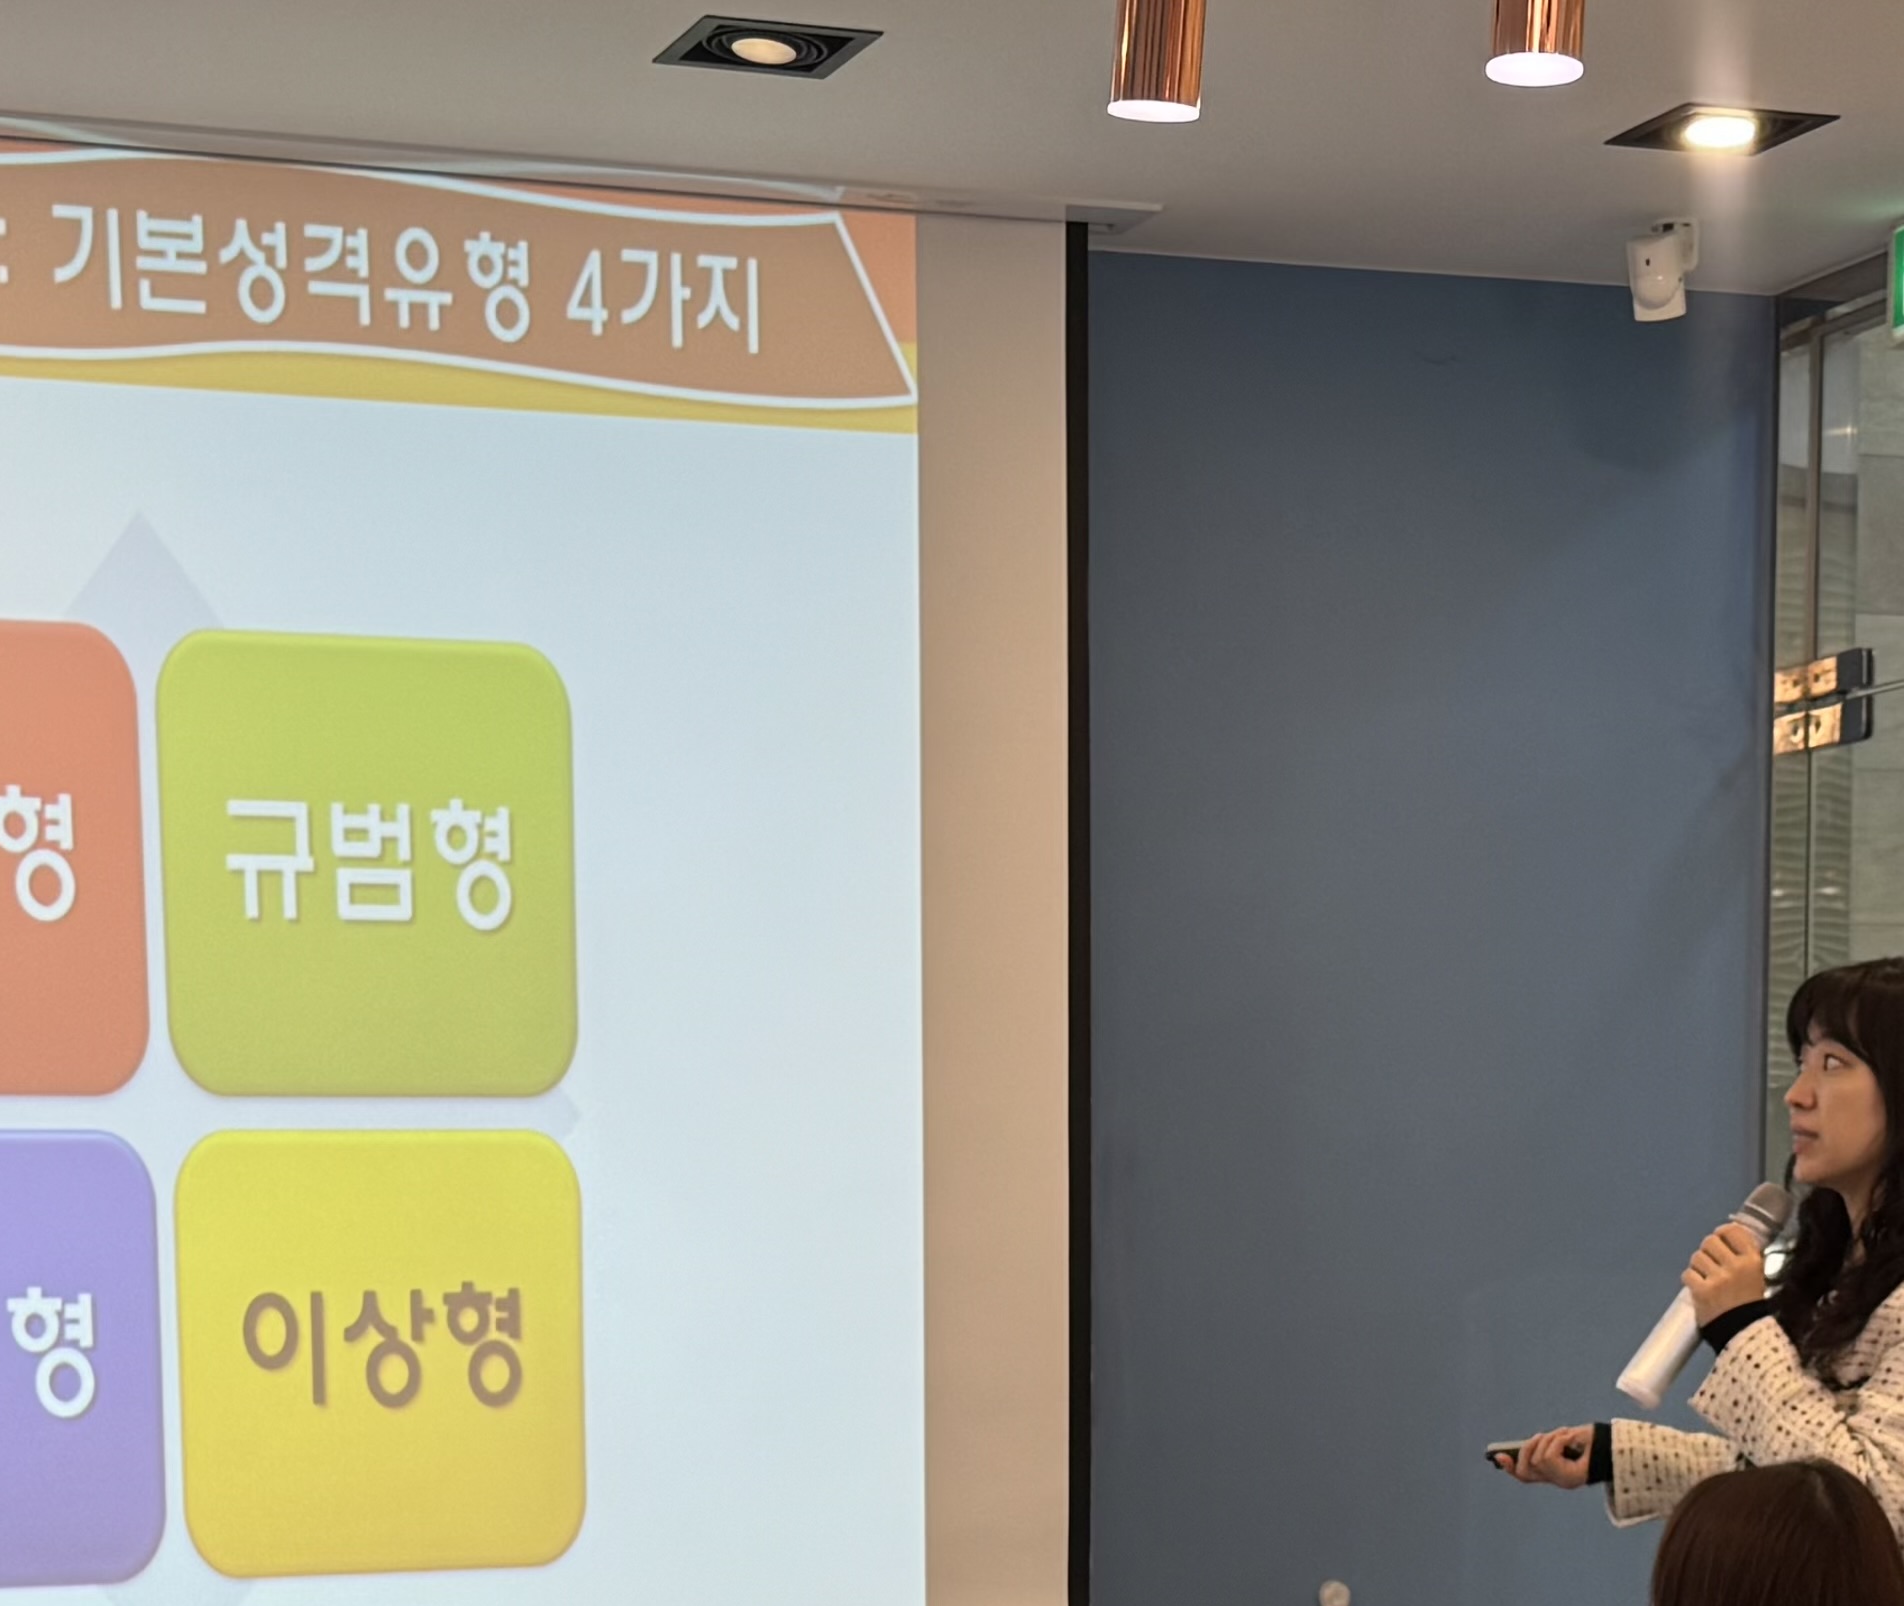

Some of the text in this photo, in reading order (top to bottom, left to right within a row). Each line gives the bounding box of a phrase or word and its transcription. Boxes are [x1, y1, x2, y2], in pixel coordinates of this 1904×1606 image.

[51, 203, 531, 343] 기본성격유형
[566, 249, 760, 355] 4가지
[225, 797, 513, 931] 규범형
[242, 1280, 524, 1409] 이상형
